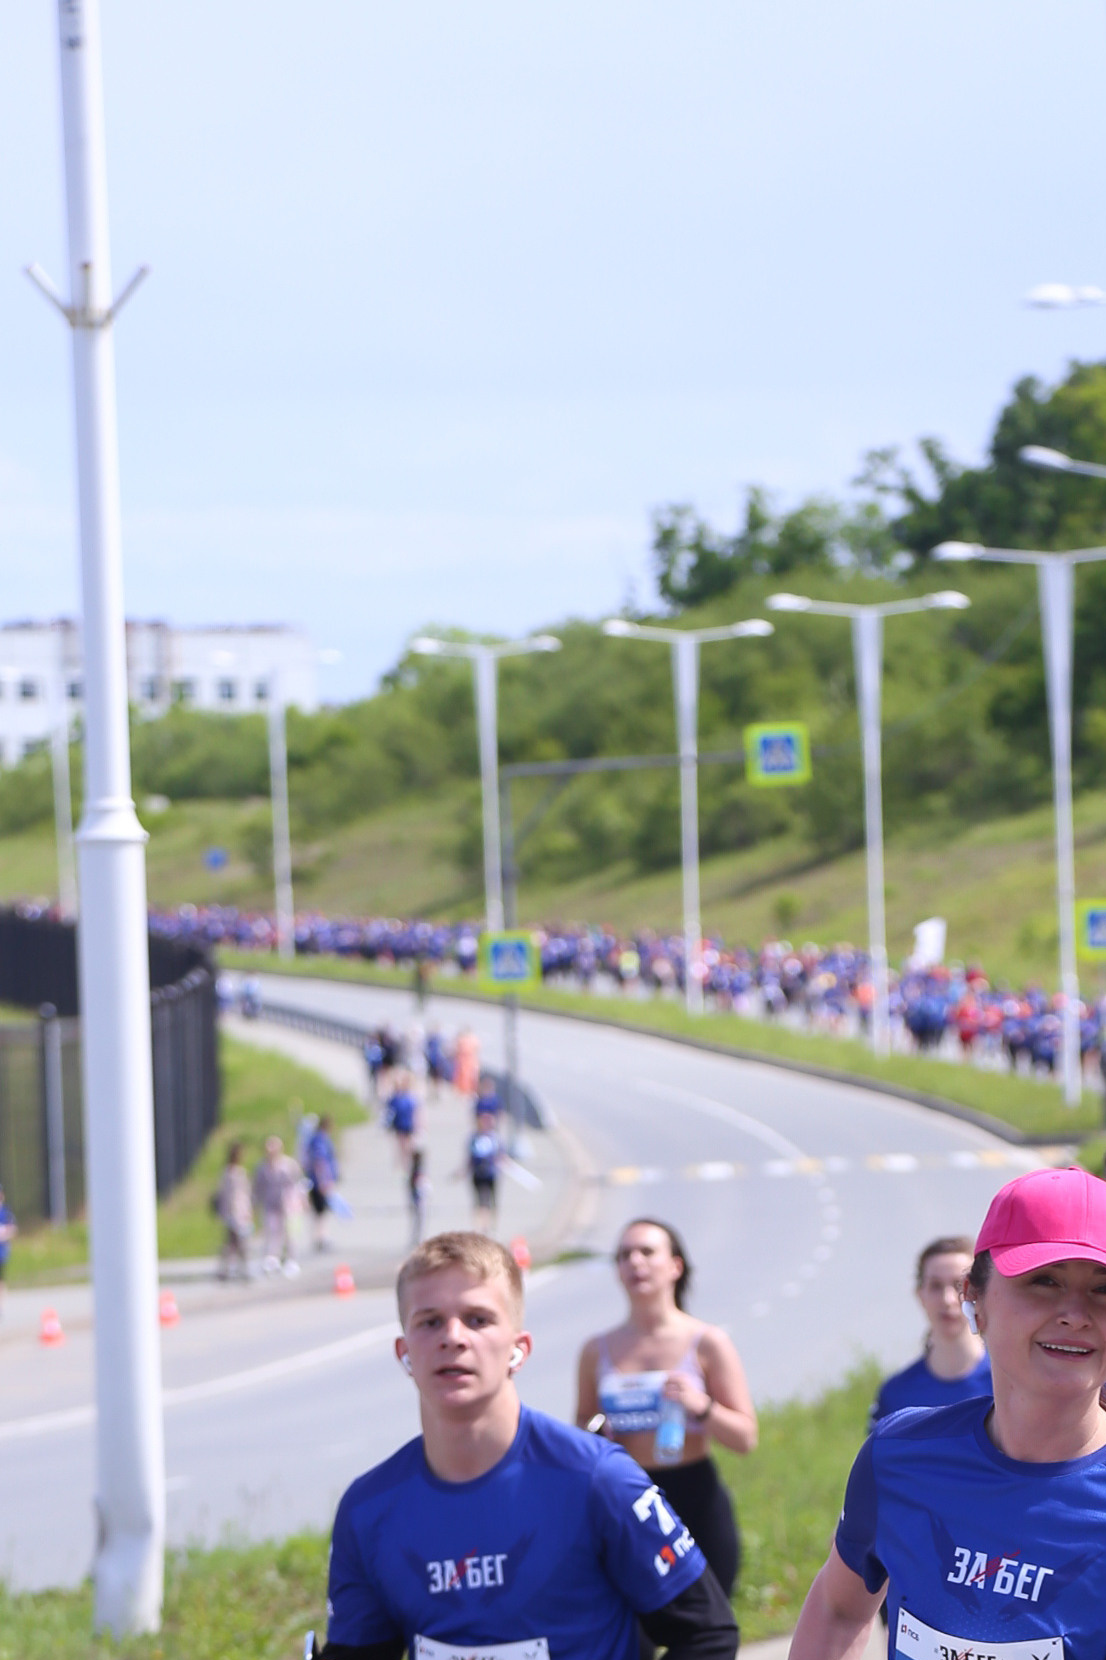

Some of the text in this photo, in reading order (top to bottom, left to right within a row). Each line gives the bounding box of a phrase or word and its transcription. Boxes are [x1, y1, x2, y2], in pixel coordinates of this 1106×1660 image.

[632, 1484, 677, 1537] 7
[426, 1552, 508, 1594] ЗАБЕГ
[946, 1546, 1055, 1603] ЗАБЕГ
